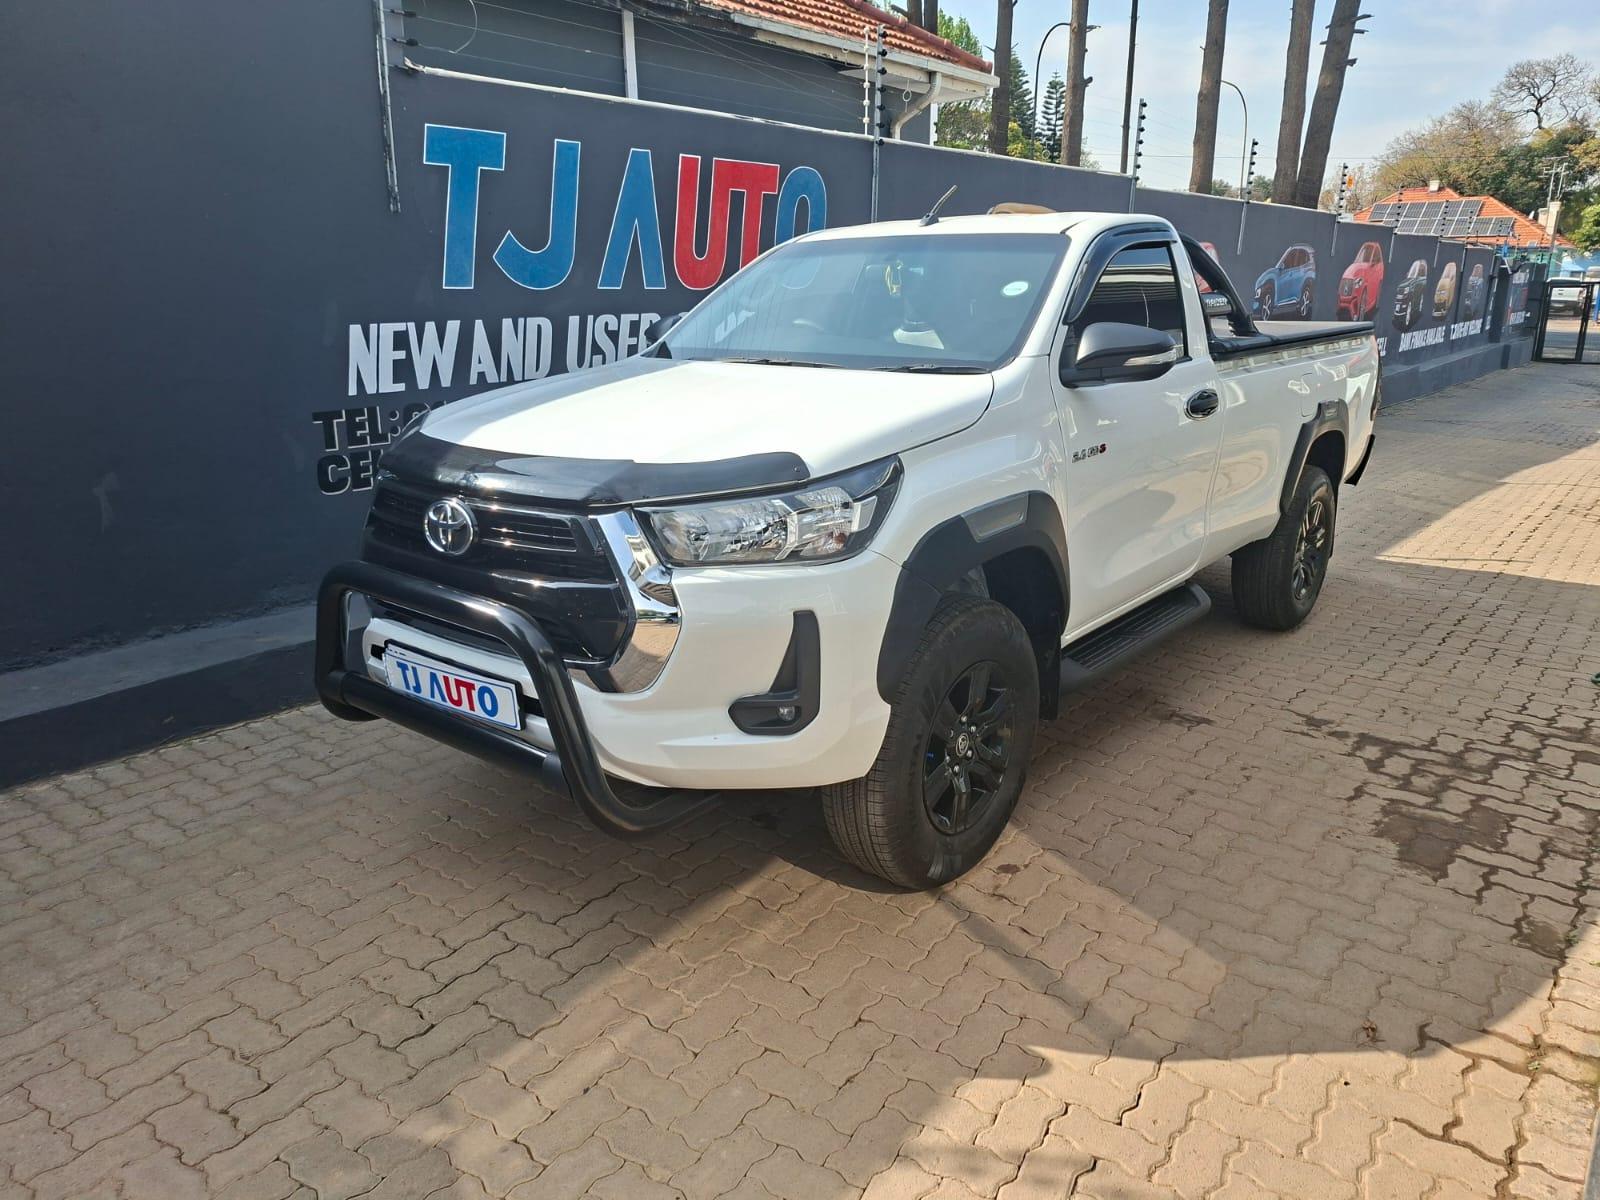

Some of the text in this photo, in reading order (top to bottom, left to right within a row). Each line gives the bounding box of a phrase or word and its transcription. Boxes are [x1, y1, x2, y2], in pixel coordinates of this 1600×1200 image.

[423, 123, 827, 291] TJ AUTO
[347, 319, 461, 396] NEW
[469, 316, 553, 386] AND
[317, 449, 384, 496] CE
[396, 660, 499, 718] TJ AUTO
